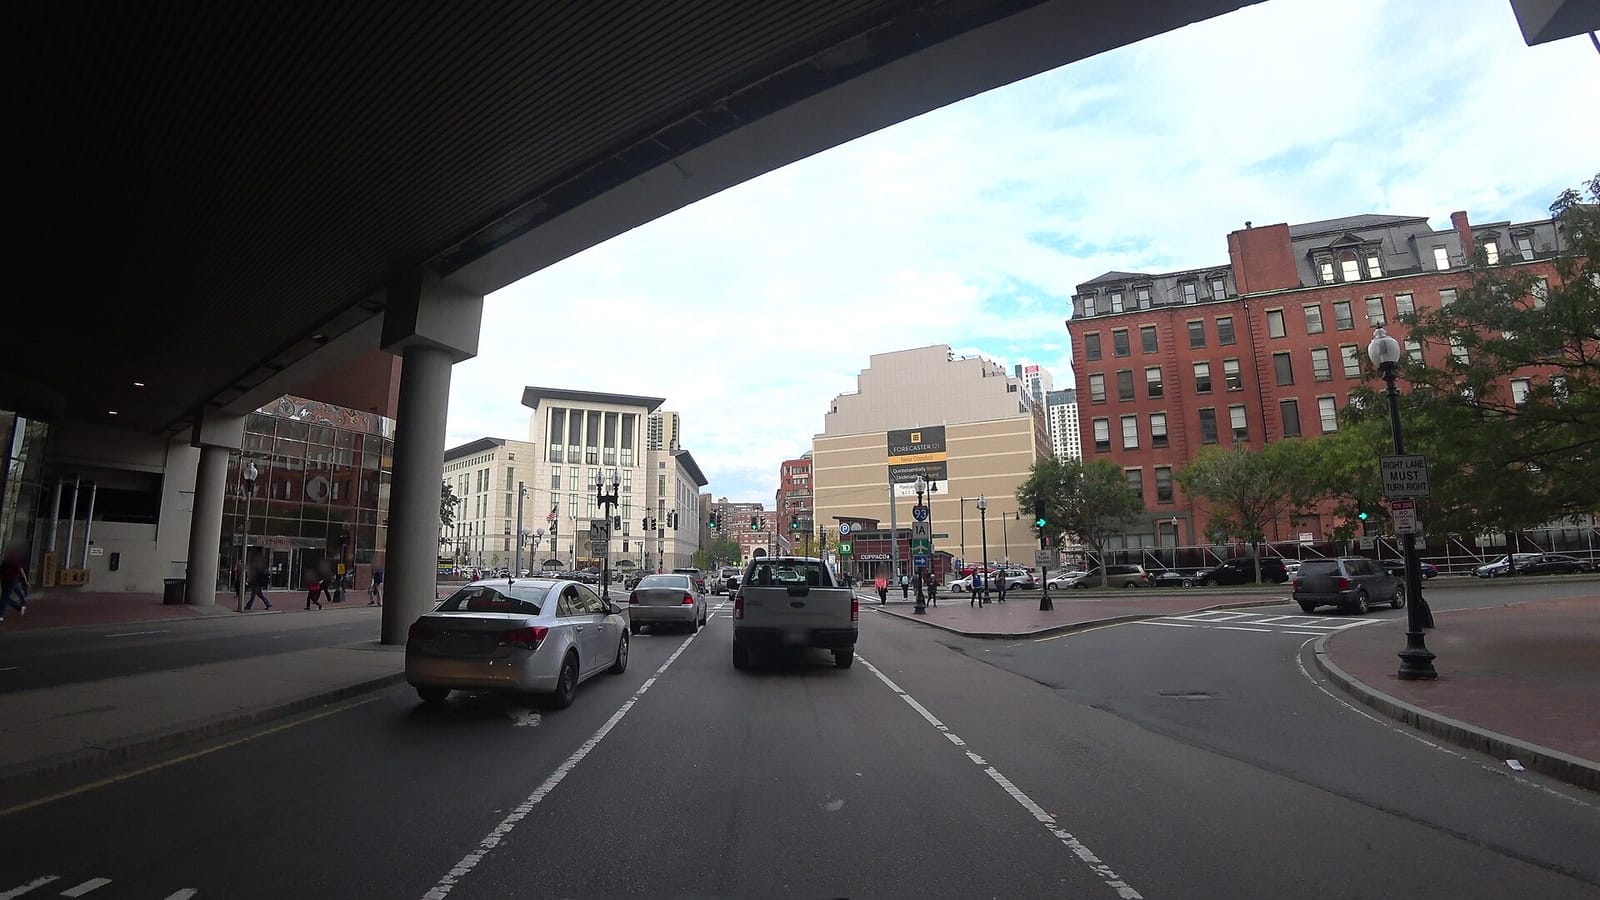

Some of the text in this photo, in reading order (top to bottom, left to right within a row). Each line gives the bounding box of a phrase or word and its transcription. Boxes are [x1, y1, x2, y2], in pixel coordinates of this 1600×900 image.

[893, 443, 931, 453] FORECASTER
[1382, 459, 1425, 469] RIGHT LANE
[1390, 470, 1419, 481] MUST
[1386, 481, 1427, 491] TURN RIGHT
[914, 509, 927, 519] 93
[915, 525, 926, 535] 1A
[841, 544, 851, 552] TD
